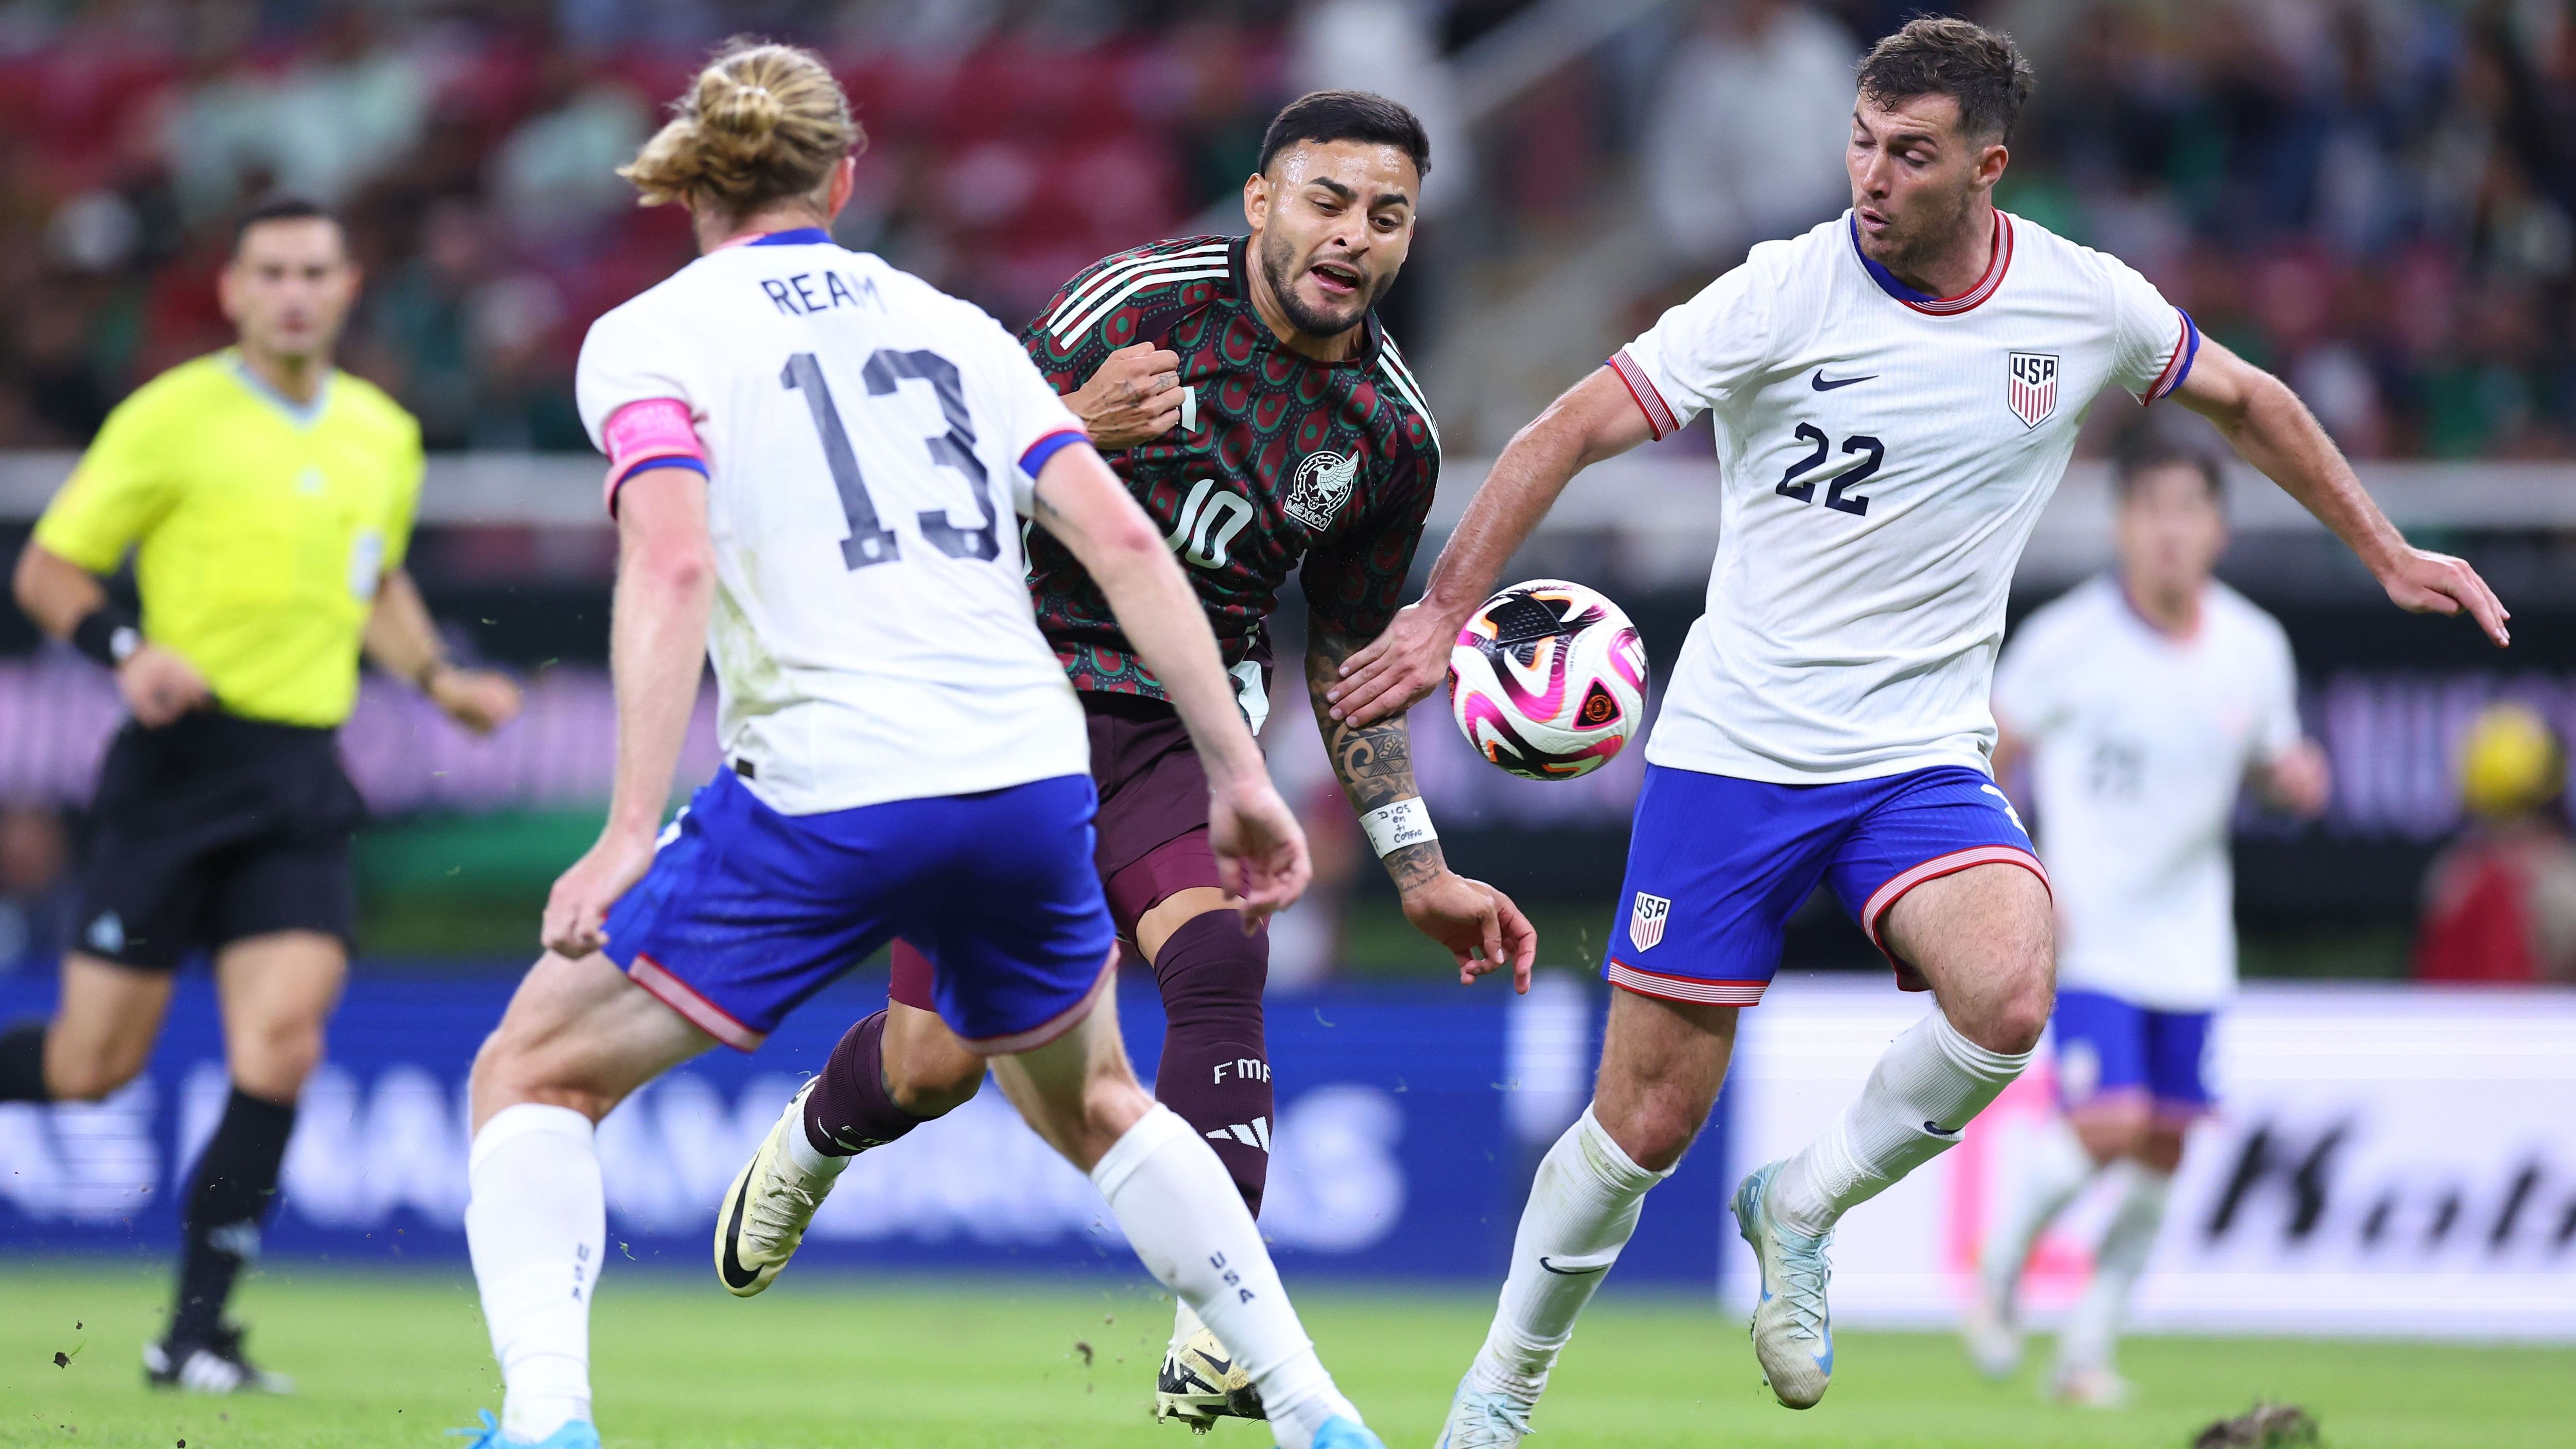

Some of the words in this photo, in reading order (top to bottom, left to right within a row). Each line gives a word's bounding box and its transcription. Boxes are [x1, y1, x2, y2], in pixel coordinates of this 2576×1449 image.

[760, 270, 888, 315] REAM
[2013, 357, 2055, 385] USA
[780, 349, 1000, 571] 13
[1776, 422, 1885, 516] 22
[1165, 479, 1253, 569] 10
[1286, 500, 1327, 527] MÉXICO
[1637, 895, 1667, 919] USA
[572, 1243, 590, 1302] USA
[1210, 1251, 1255, 1304] USA
